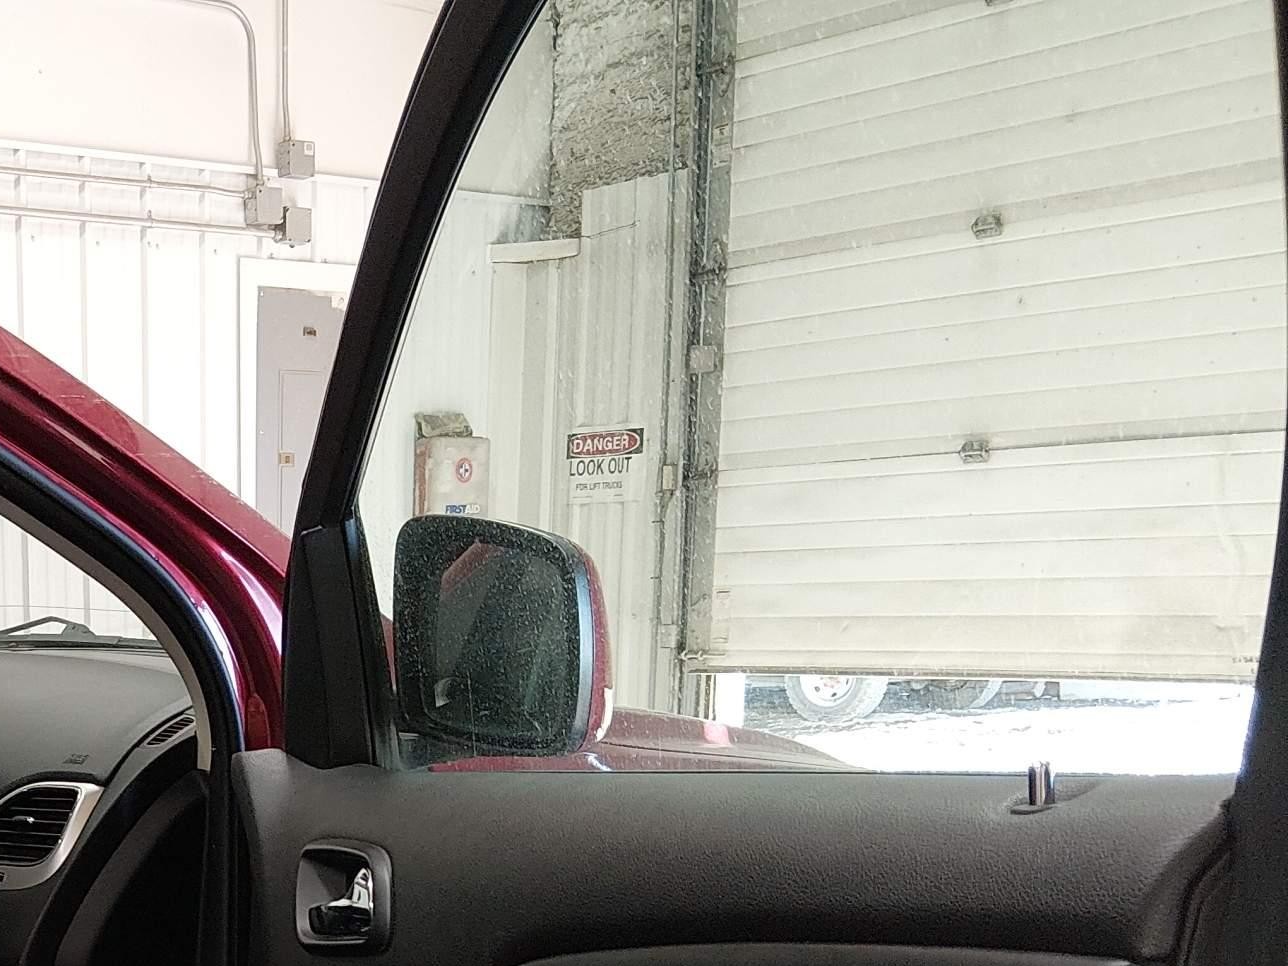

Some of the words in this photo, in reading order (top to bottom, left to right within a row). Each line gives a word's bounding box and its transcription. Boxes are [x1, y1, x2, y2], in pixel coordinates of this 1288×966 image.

[573, 434, 629, 453] DANGER
[569, 458, 605, 477] LOOK
[608, 456, 633, 474] OUT
[575, 483, 588, 491] FOR
